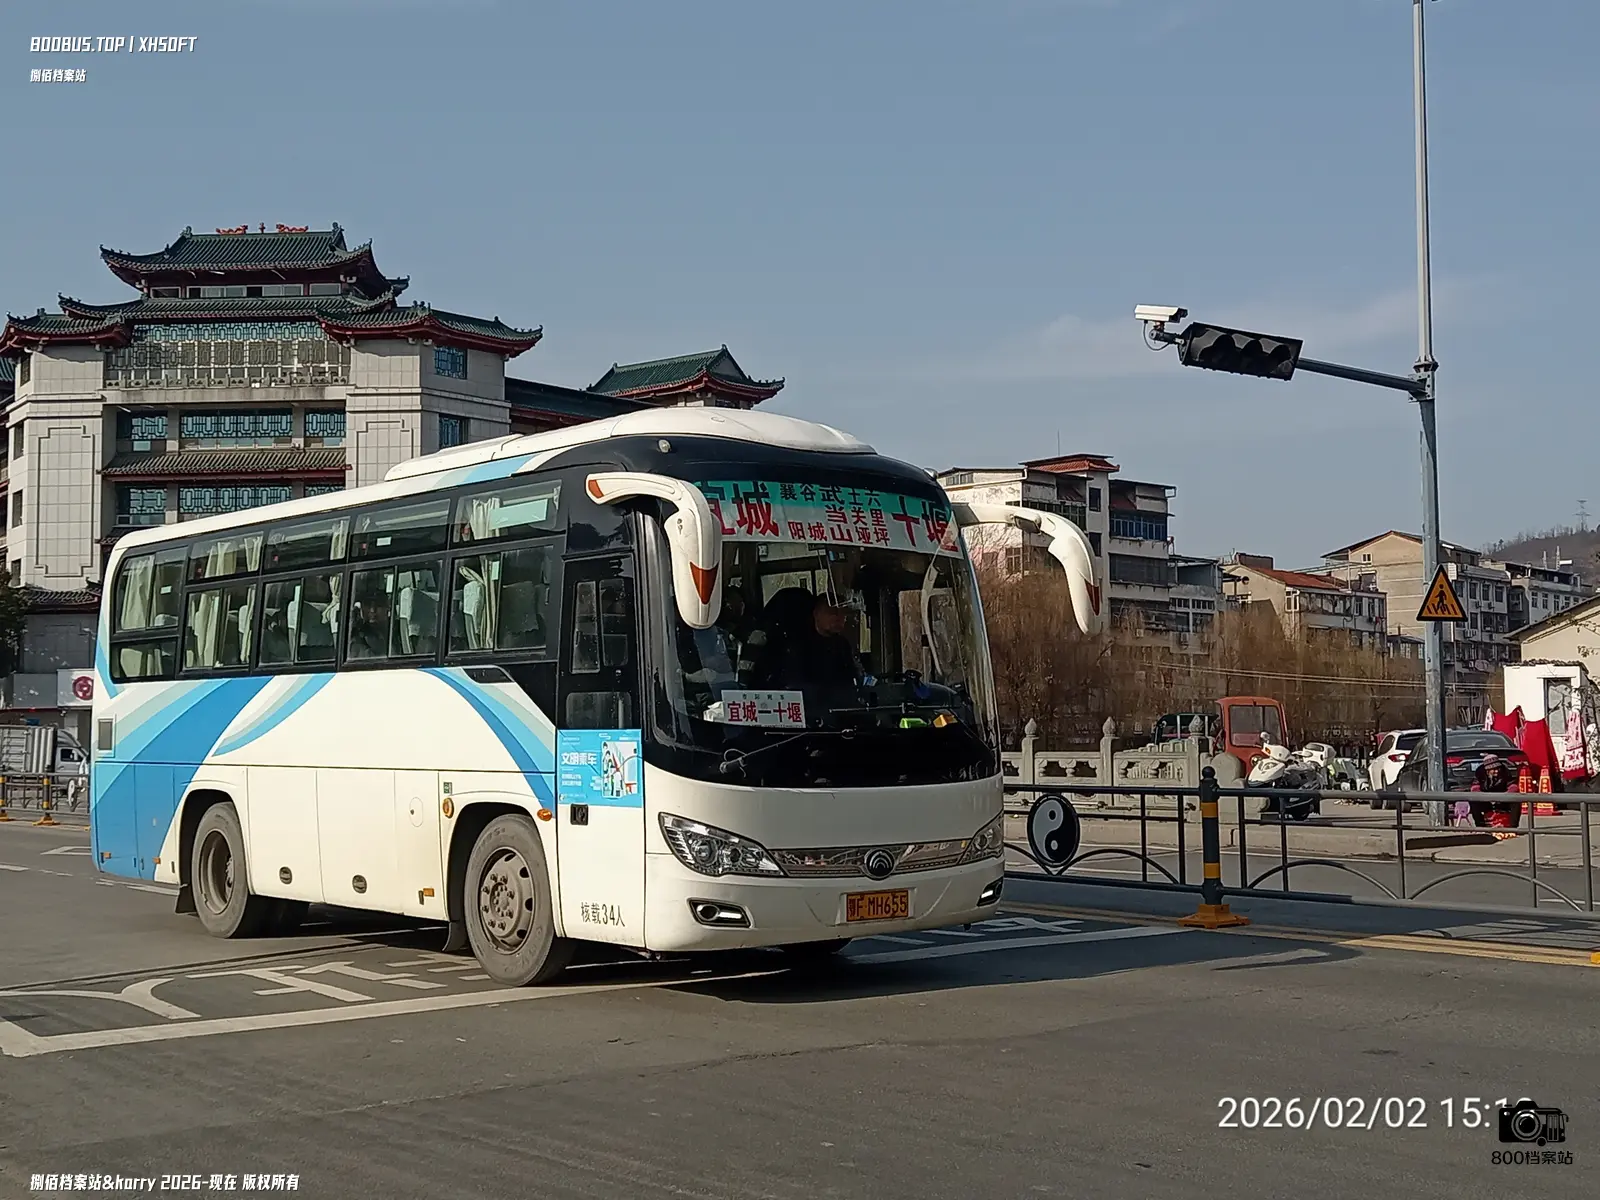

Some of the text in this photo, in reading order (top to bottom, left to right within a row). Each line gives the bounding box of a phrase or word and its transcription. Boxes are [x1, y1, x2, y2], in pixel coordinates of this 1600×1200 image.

[780, 483, 807, 541] 襄阳
[800, 483, 828, 542] 谷城
[818, 485, 854, 543] 武当山
[864, 490, 891, 547] 六里坪
[890, 495, 960, 553] 十堰
[580, 901, 626, 927] 核载34人
